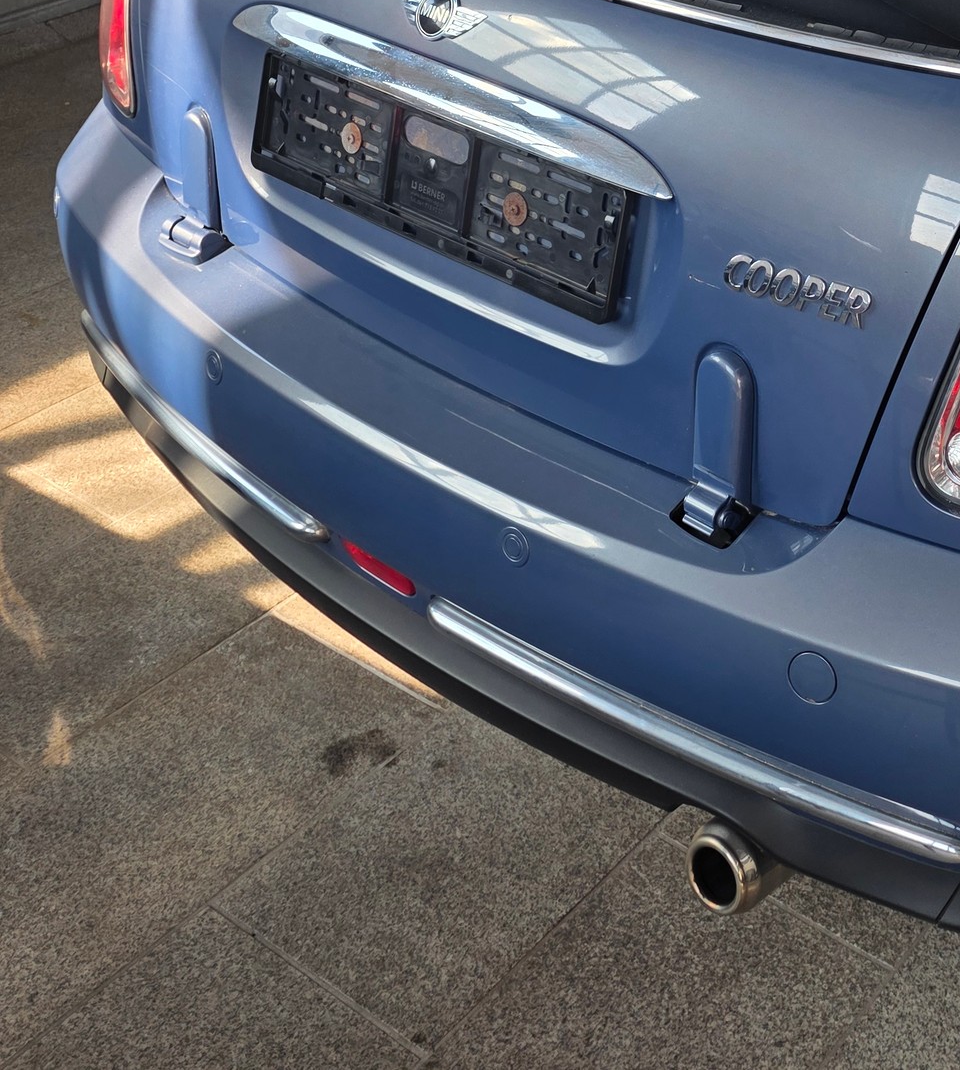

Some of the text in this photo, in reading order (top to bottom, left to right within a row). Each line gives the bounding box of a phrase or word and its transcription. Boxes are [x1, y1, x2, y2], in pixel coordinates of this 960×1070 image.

[420, 2, 450, 25] MINI
[418, 183, 446, 202] BERNER
[724, 254, 872, 330] COOPER
